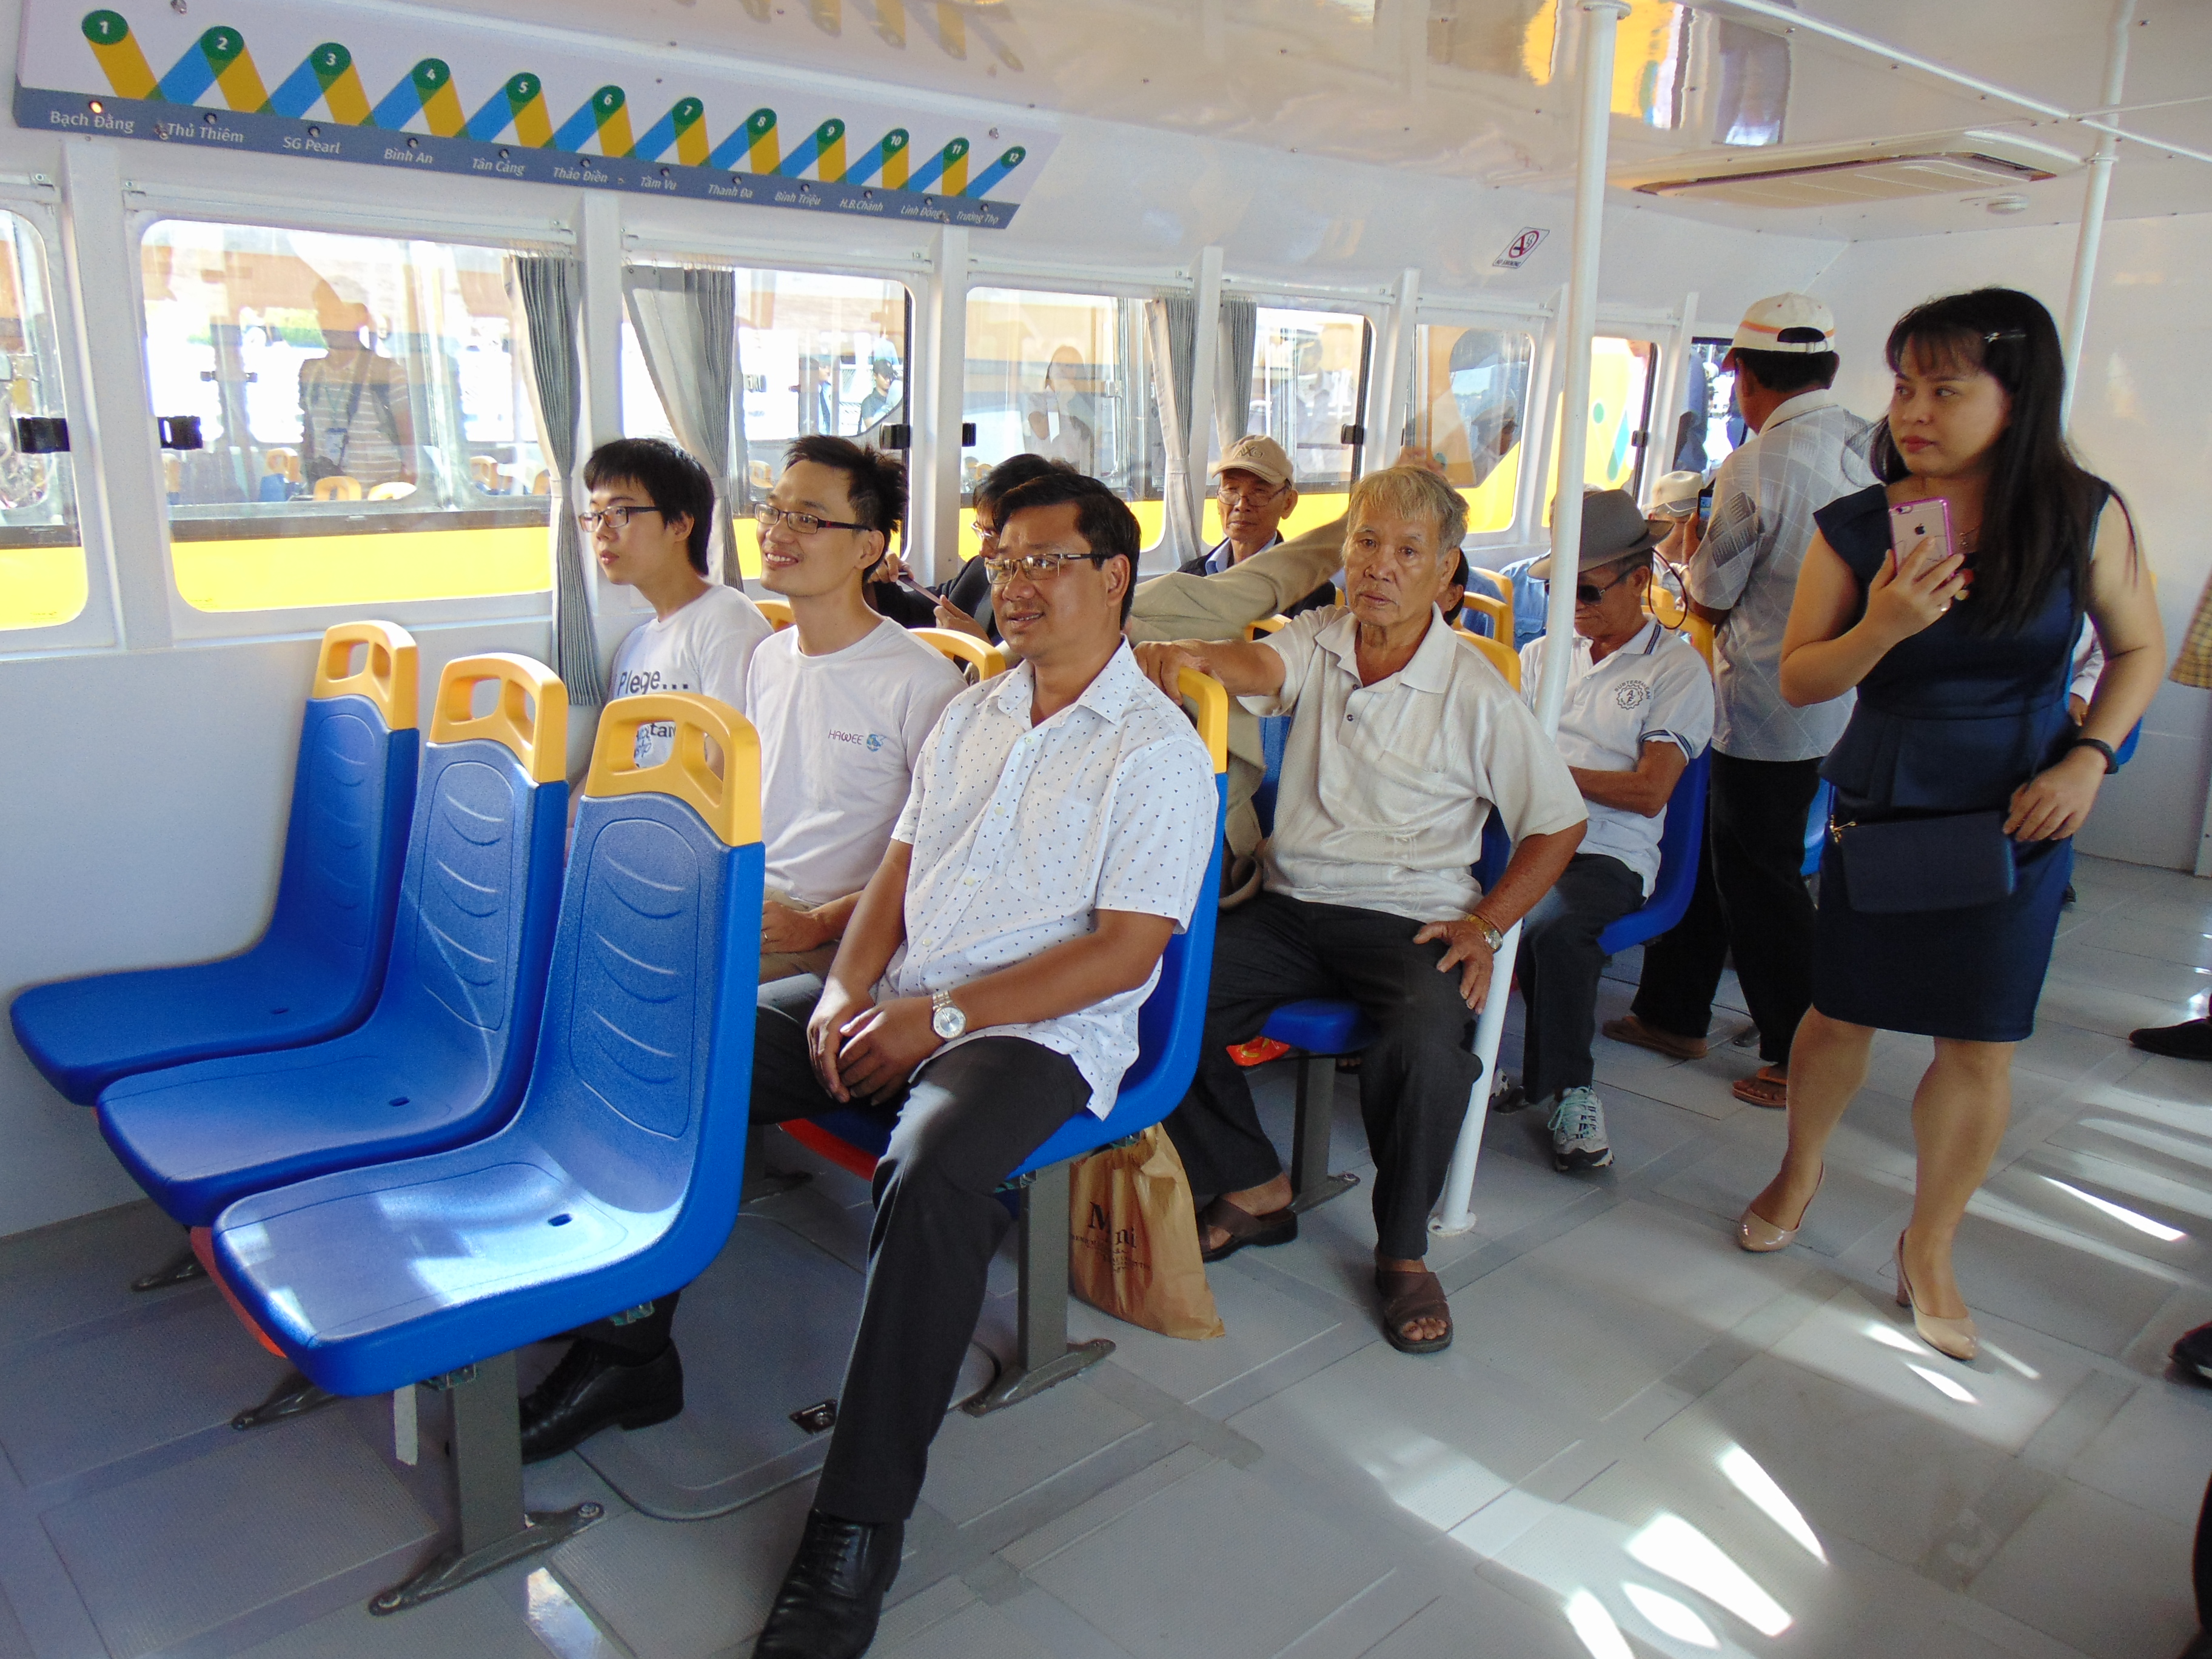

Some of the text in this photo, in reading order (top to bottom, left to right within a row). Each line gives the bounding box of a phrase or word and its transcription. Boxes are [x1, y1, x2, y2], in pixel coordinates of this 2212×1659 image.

[99, 21, 109, 34] 1
[216, 37, 228, 50] 2
[326, 53, 337, 65] 3
[426, 69, 436, 80] 4
[518, 82, 529, 93] 5
[604, 94, 613, 106] 6
[684, 105, 692, 116] 7
[50, 110, 135, 134] Bạch Đằng
[757, 116, 766, 127] 8
[168, 122, 244, 143] Thủ Thiêm
[826, 126, 835, 137] 9
[283, 136, 341, 154] SG Pearl
[891, 135, 902, 146] 10
[384, 147, 434, 164] Bình An
[952, 144, 962, 155] 11
[1010, 152, 1019, 163] 12
[472, 158, 526, 176] Tân Cảng
[554, 167, 580, 180] Thảo
[665, 179, 677, 190] Vu
[708, 184, 754, 199] Thanh Đa
[774, 191, 797, 203] Bình
[900, 205, 919, 215] Linh
[984, 213, 999, 226] Thọ
[828, 729, 864, 745] HAWEE
